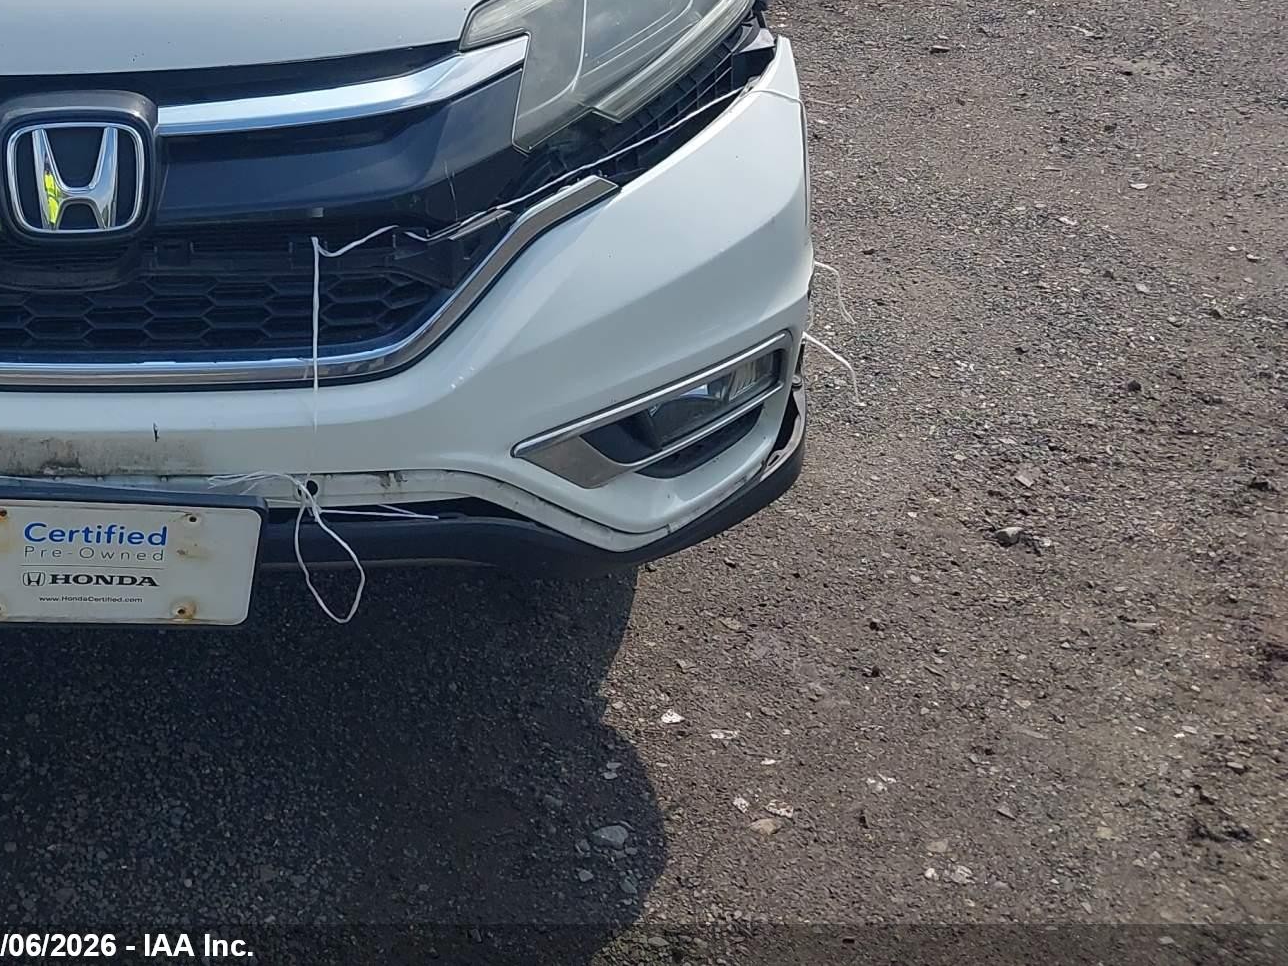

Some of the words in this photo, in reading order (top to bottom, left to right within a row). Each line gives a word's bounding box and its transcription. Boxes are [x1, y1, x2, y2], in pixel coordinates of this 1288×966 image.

[24, 522, 168, 546] Certified
[24, 546, 165, 562] Pre-Owned
[49, 574, 159, 587] HONDA
[39, 595, 143, 604] www.HondaCertified.com
